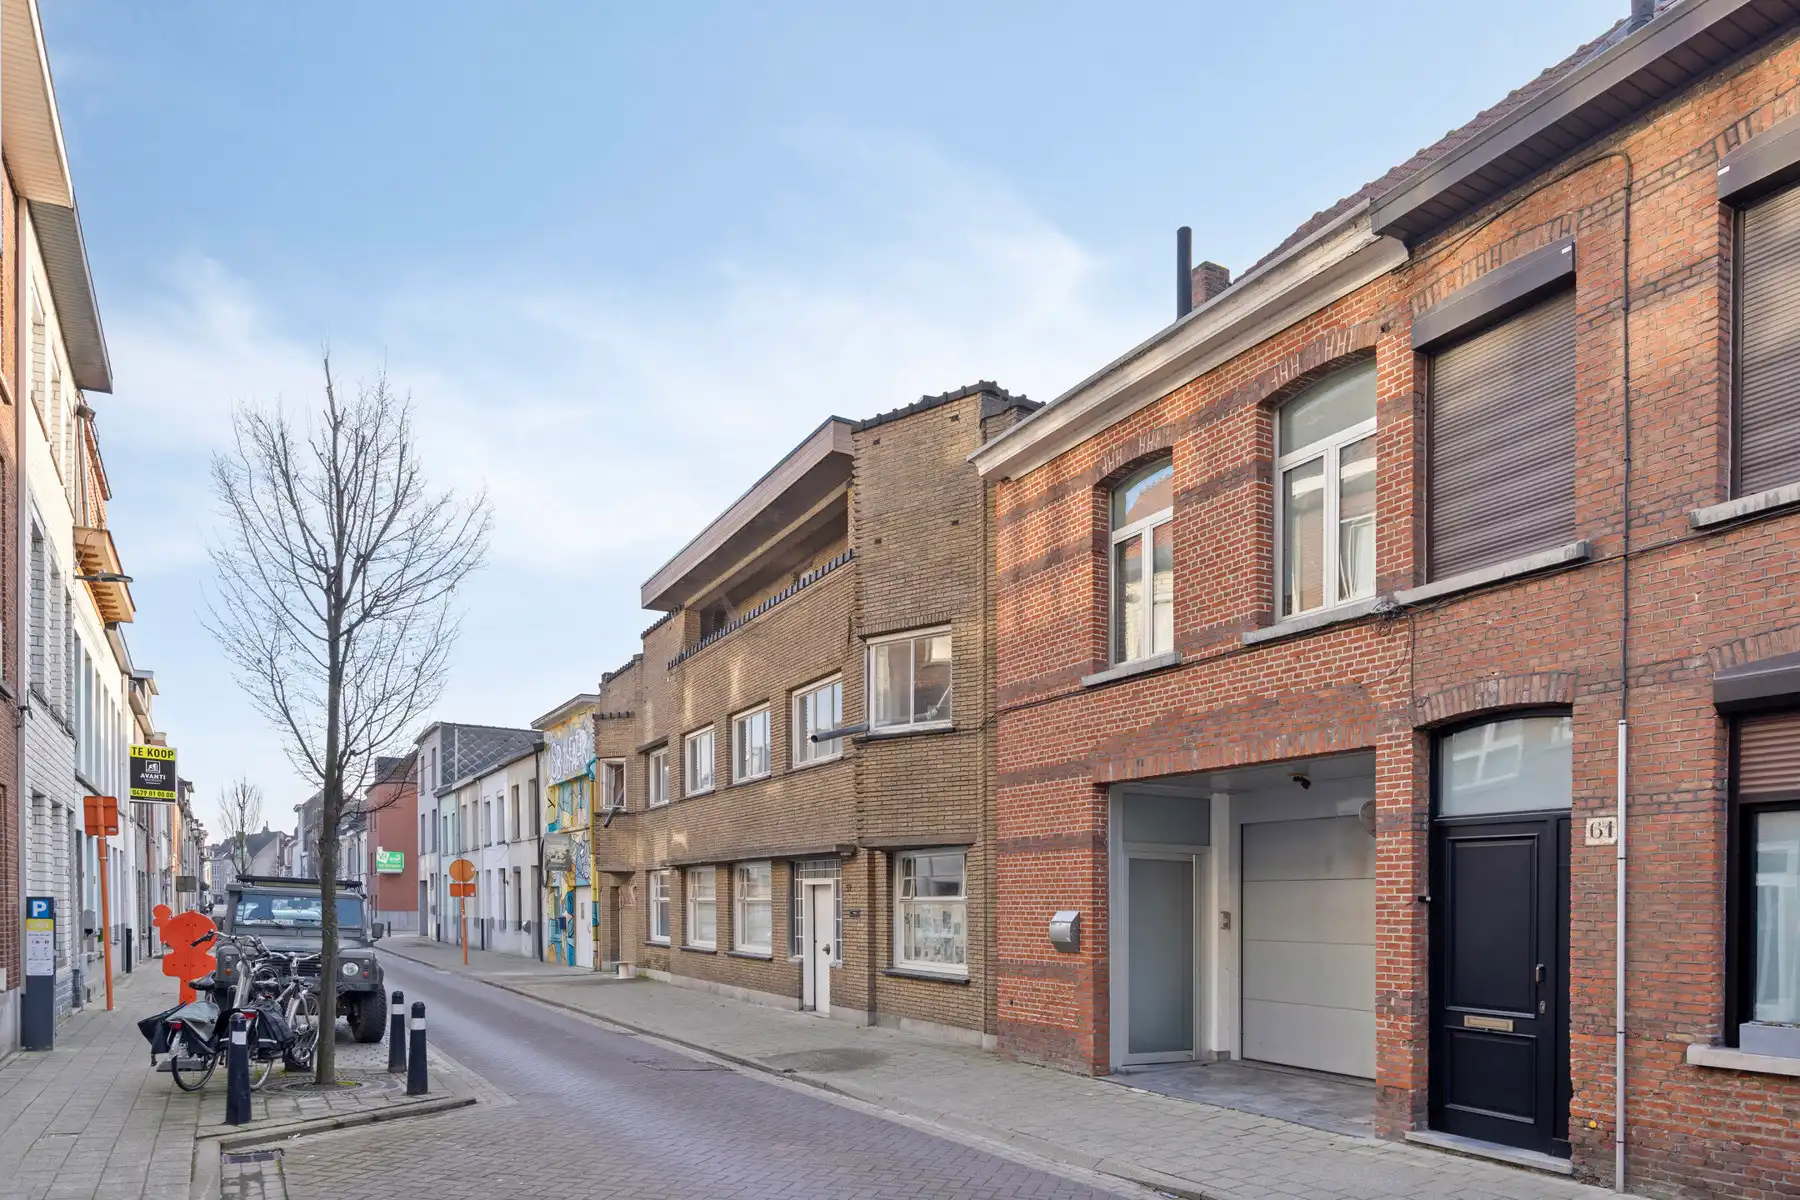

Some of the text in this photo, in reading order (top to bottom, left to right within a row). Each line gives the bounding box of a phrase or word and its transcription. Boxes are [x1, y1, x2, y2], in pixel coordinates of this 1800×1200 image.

[131, 746, 174, 759] TE KOOP
[132, 789, 148, 797] 0479
[1590, 820, 1613, 839] 61
[32, 900, 47, 917] P
